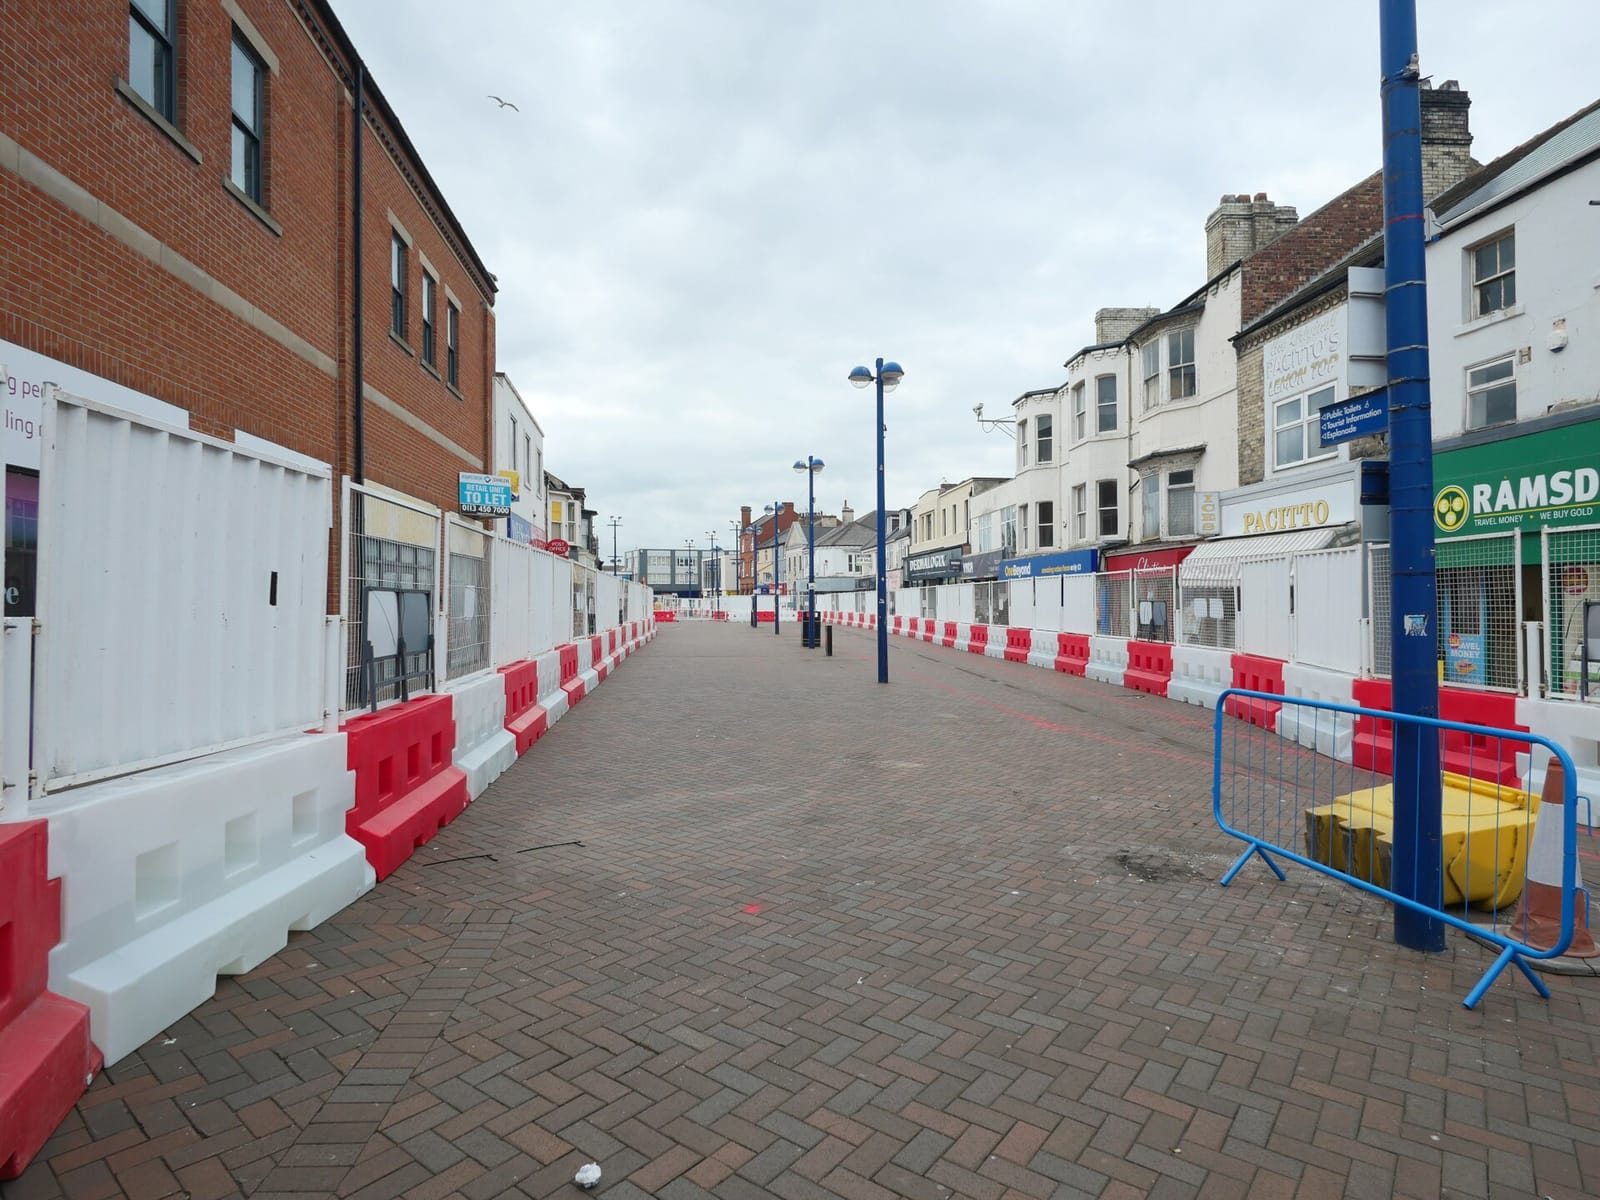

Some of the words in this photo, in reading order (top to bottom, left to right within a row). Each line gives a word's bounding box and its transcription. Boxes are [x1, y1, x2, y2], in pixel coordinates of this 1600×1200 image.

[1268, 366, 1307, 397] LEMON
[1311, 352, 1340, 379] TOP
[22, 380, 43, 399] pe
[1326, 409, 1344, 420] Public
[1344, 404, 1362, 414] Toilets
[1327, 419, 1345, 430] Tourist
[1346, 408, 1382, 424] Information
[1327, 424, 1357, 440] Esplanade
[466, 484, 489, 492] RETAIL
[1473, 467, 1600, 514] RAMSD
[464, 491, 482, 503] TO
[485, 493, 507, 506] LET
[478, 505, 491, 513] 450
[493, 506, 509, 514] 7000
[1243, 499, 1330, 534] PACITTO
[1474, 517, 1498, 527] TRAVEL
[1498, 514, 1524, 524] MONEY
[1540, 511, 1552, 520] WE
[1553, 509, 1569, 519] BUY
[1570, 507, 1593, 517] GOLD
[1450, 649, 1481, 658] MONEY
